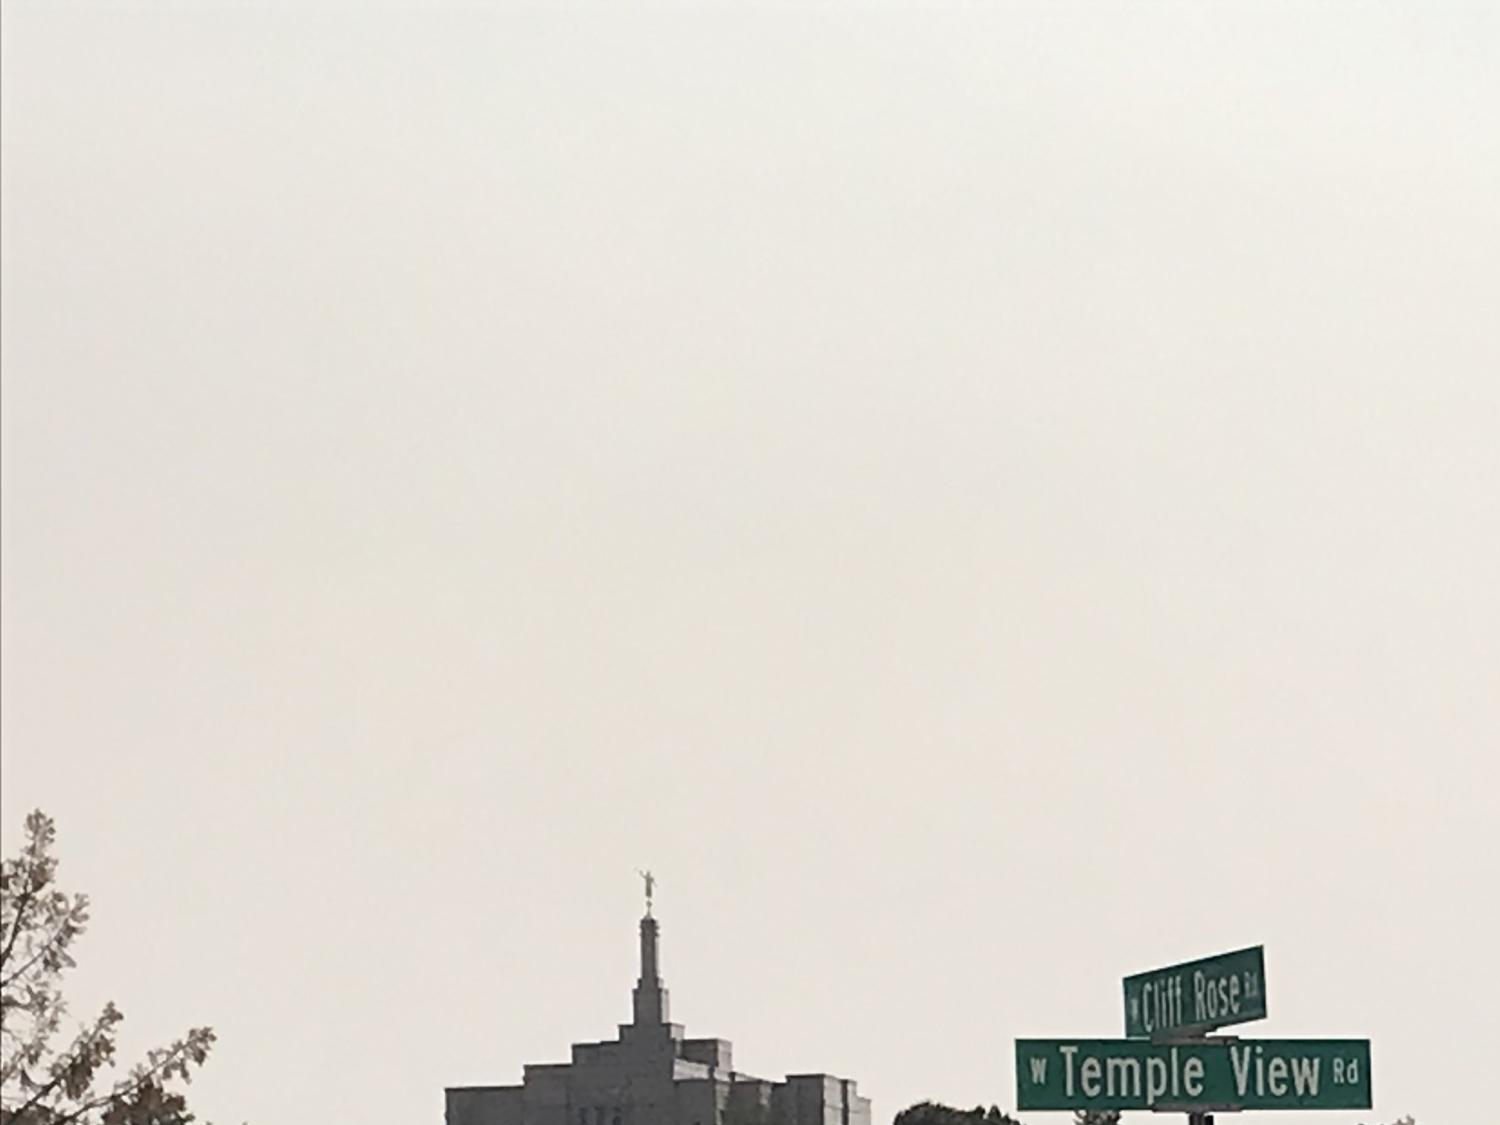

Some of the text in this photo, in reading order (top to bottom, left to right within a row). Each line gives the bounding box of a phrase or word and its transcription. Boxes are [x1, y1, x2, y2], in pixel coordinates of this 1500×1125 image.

[1142, 975, 1182, 1033] Cliff
[1193, 969, 1240, 1021] Rose
[1030, 1045, 1359, 1105] W Temple View Rd
